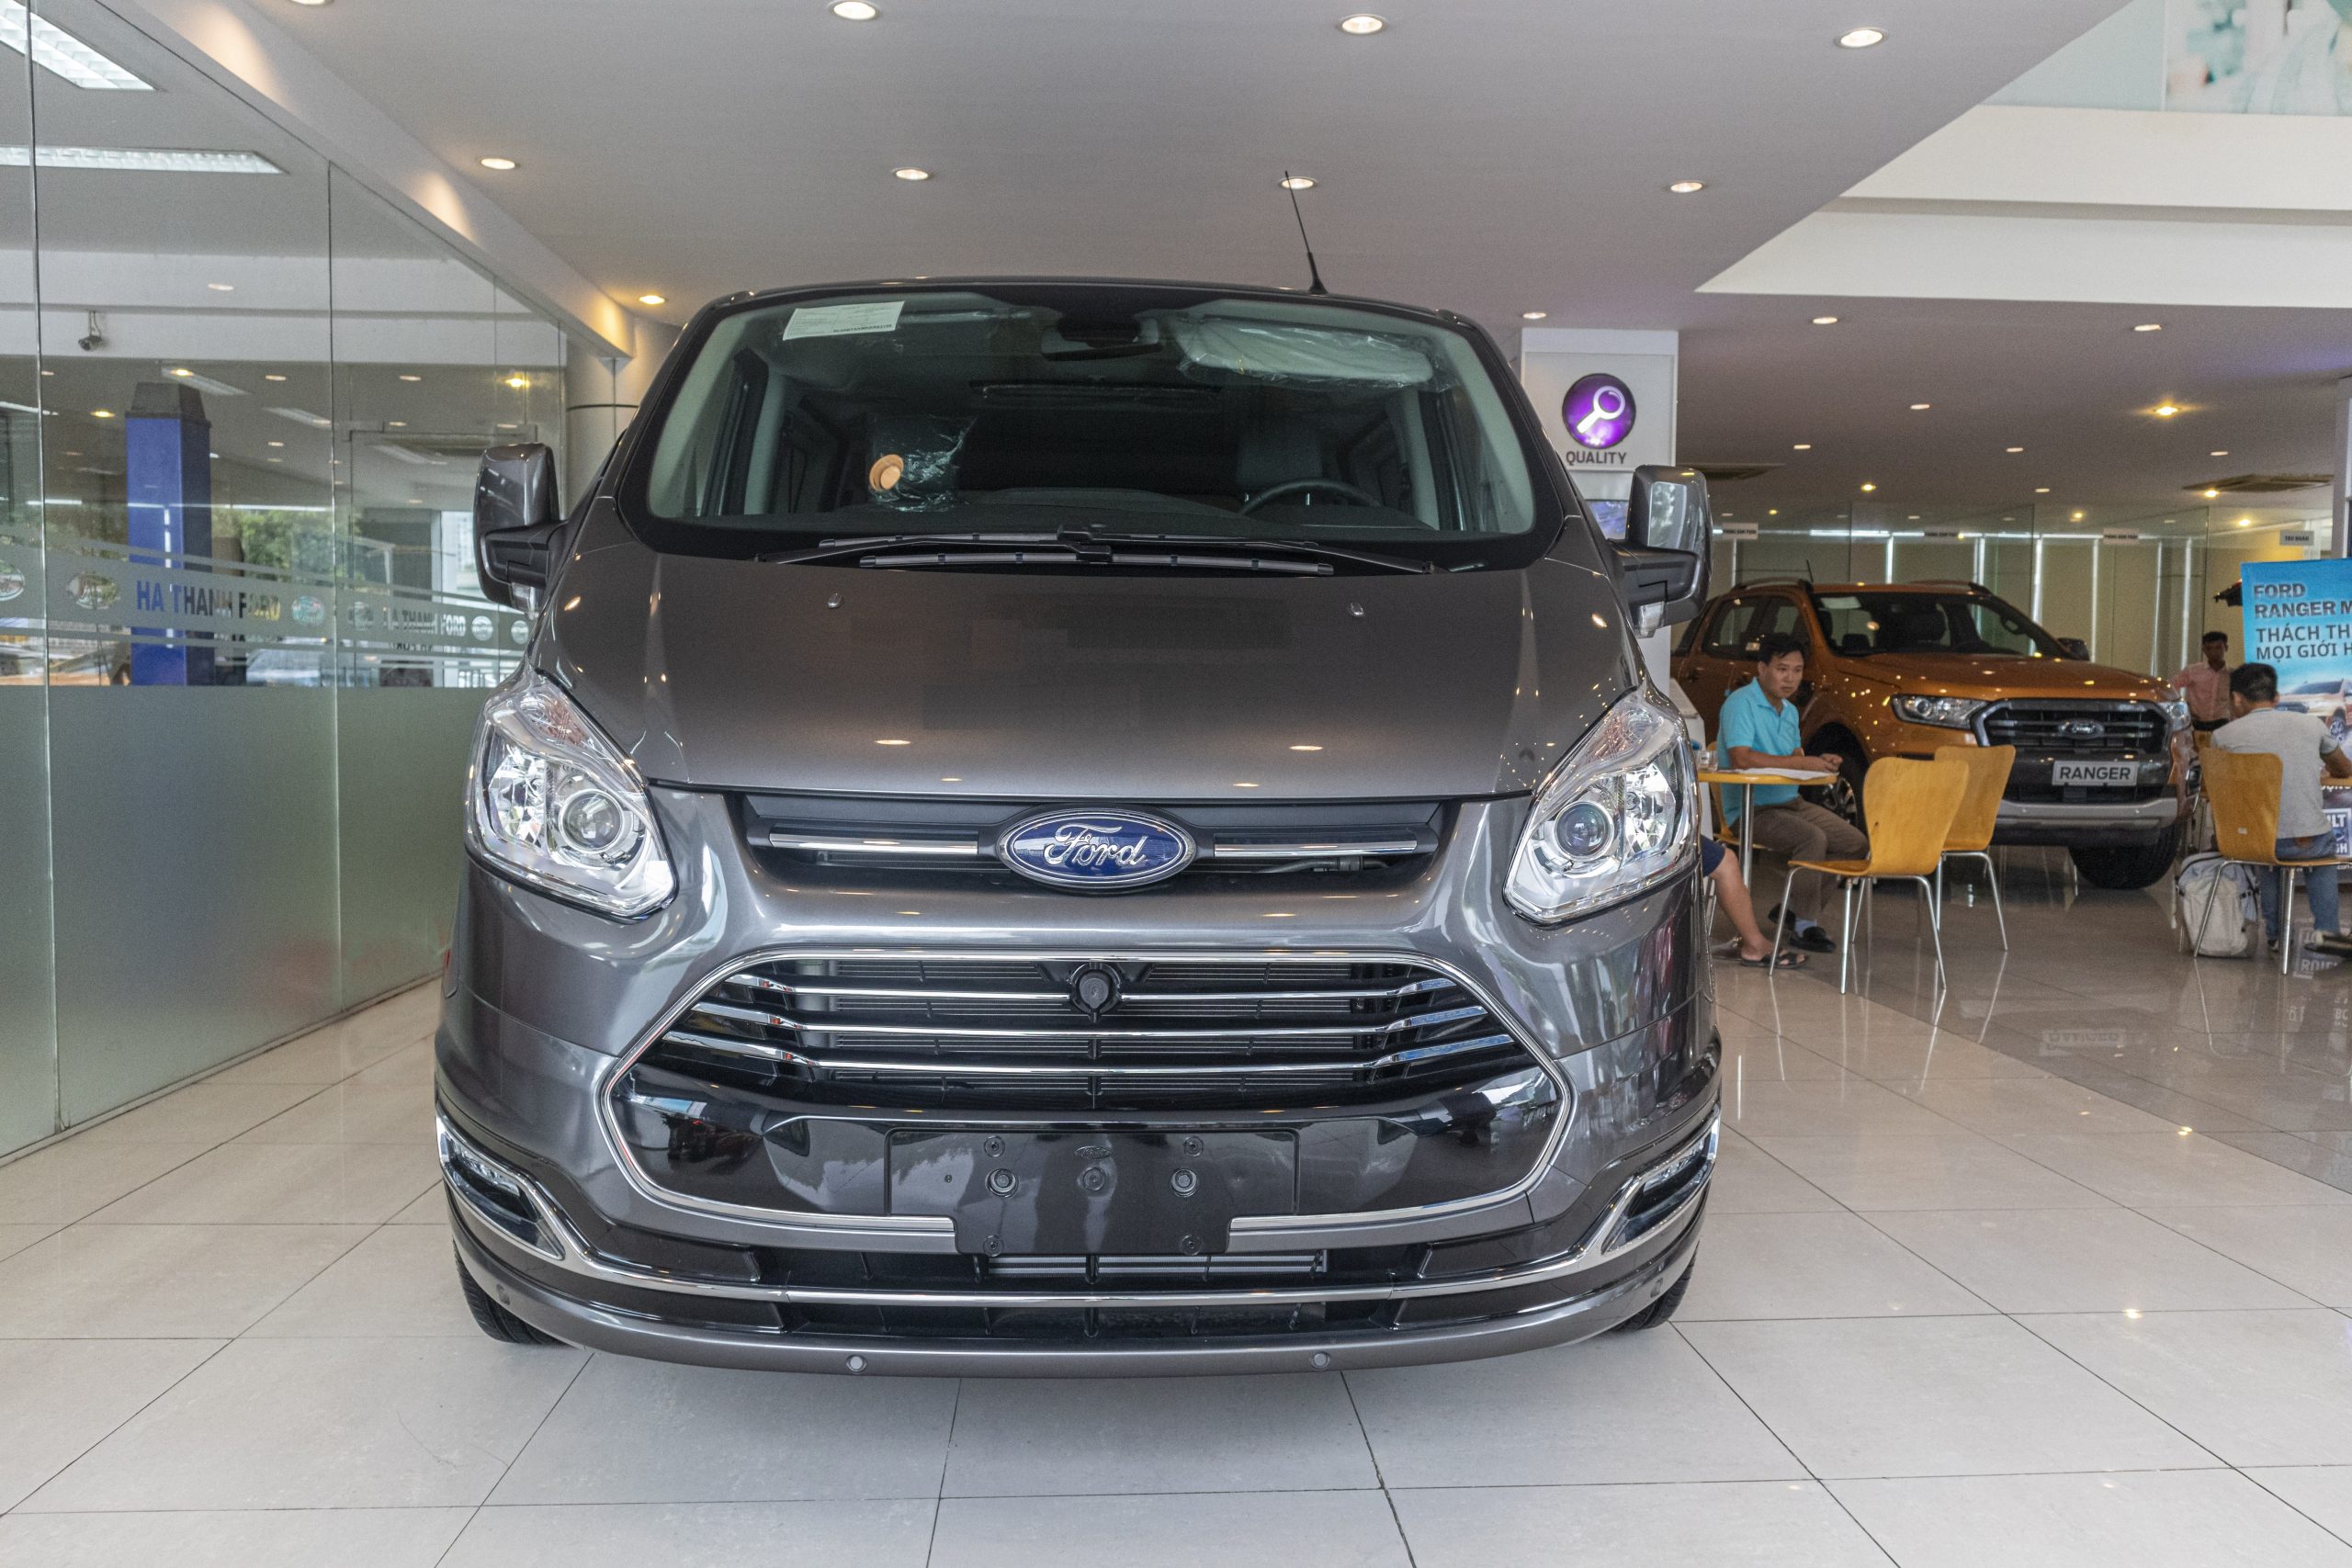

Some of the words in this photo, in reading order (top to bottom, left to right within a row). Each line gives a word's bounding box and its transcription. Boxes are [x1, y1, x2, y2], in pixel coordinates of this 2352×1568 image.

[1566, 450, 1628, 467] QUALITY
[137, 581, 165, 613] HA
[2254, 582, 2306, 600] FORD
[2255, 601, 2336, 619] RANGER
[2256, 623, 2320, 643] THÁCH
[2256, 646, 2291, 663] MỌI
[2298, 640, 2337, 659] GIỚI
[2060, 766, 2132, 781] RANGER
[1044, 823, 1148, 867] Ford
